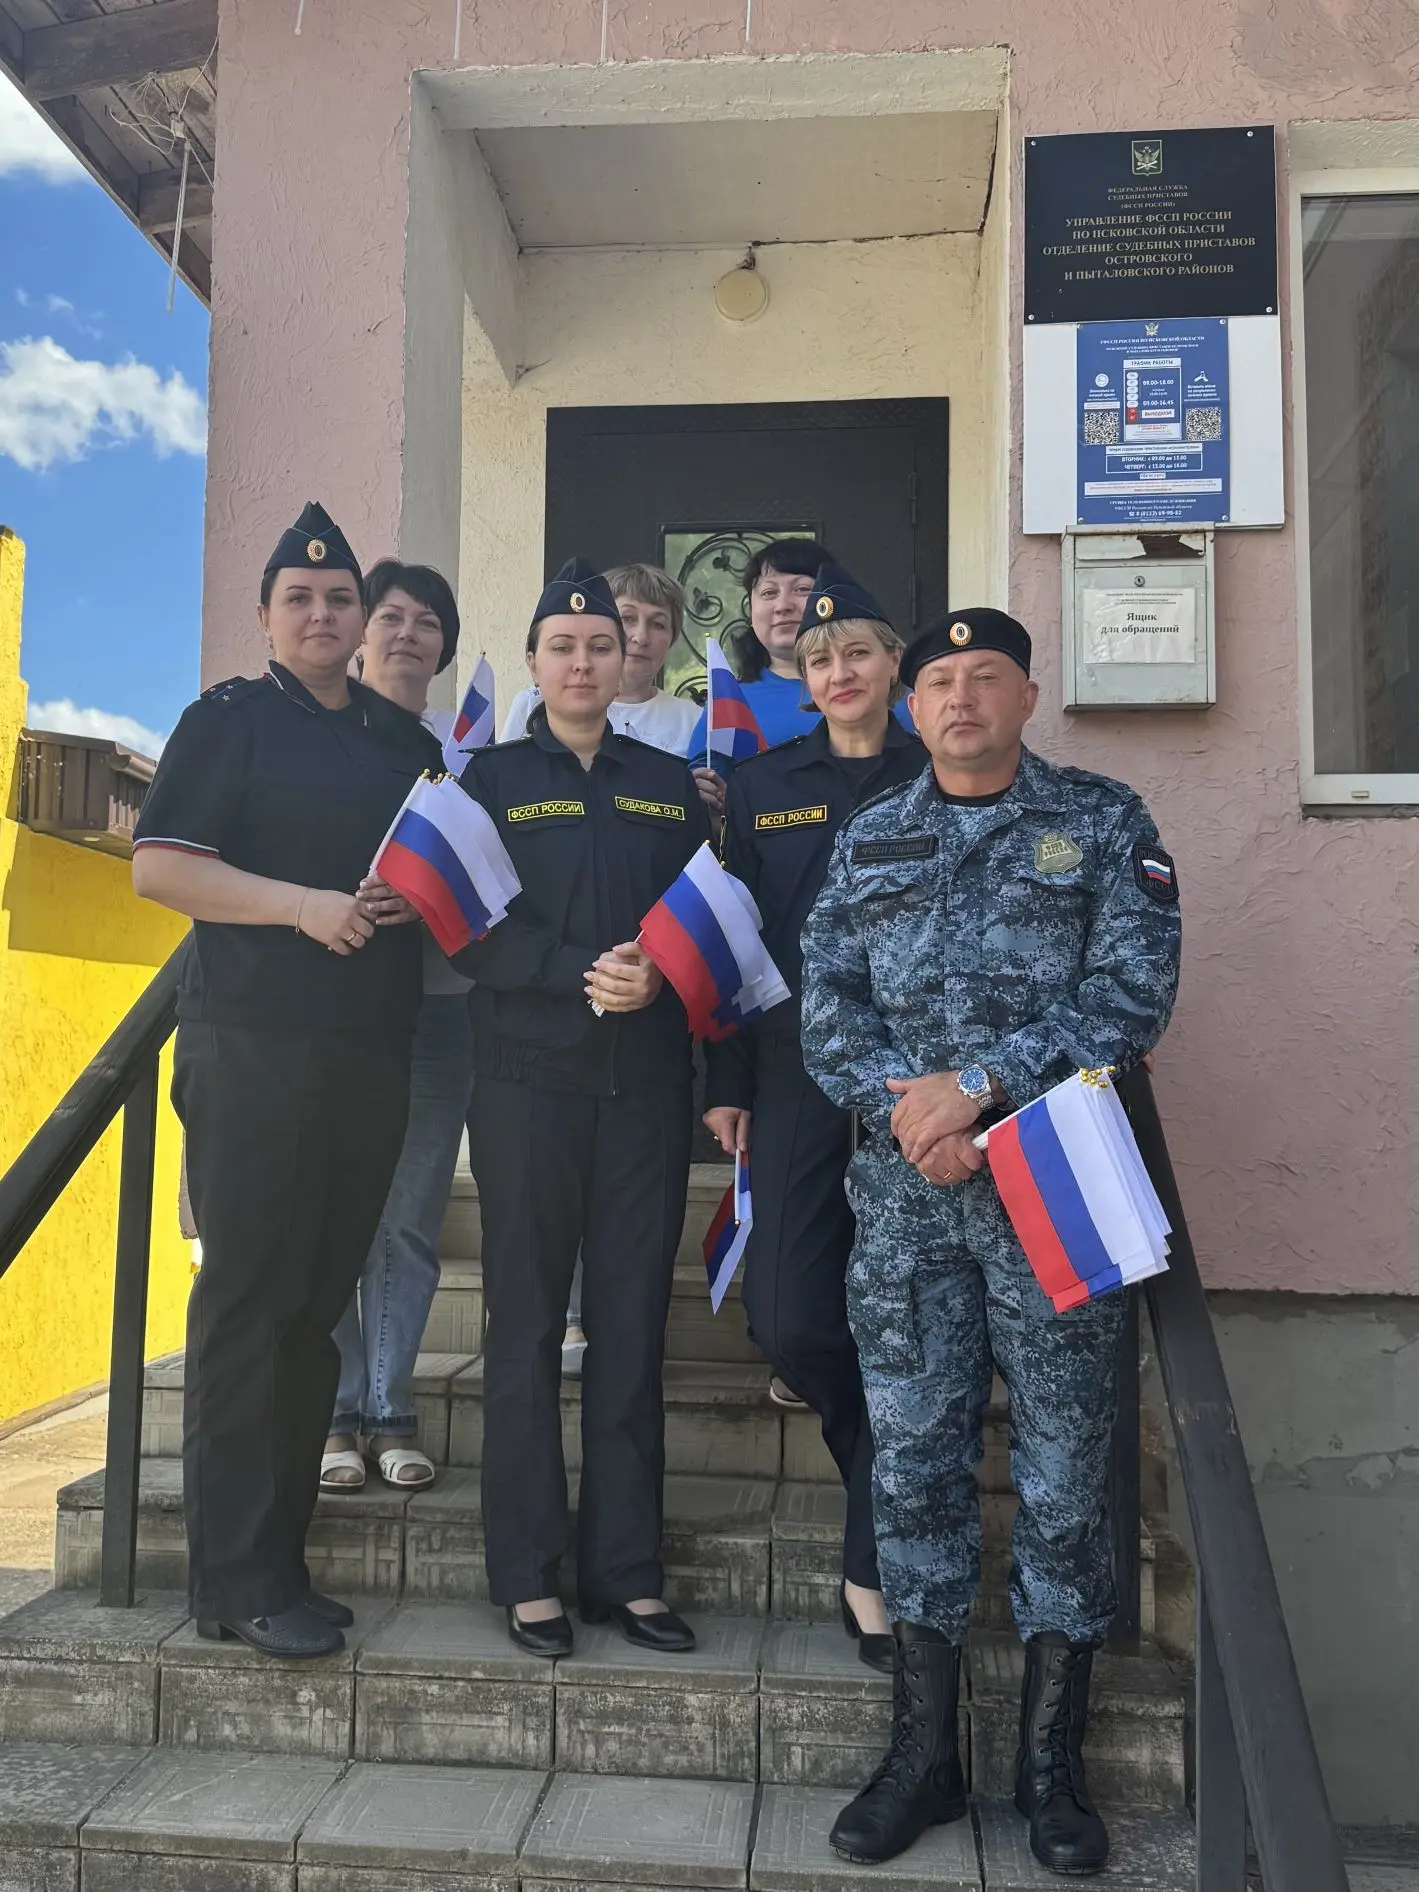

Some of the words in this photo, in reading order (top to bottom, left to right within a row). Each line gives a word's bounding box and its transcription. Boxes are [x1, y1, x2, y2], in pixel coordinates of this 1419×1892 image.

[1065, 214, 1143, 227] УПРАВЛЕНИЕ
[1146, 212, 1180, 223] ФССП
[1183, 211, 1232, 222] РОССИИ
[1072, 230, 1090, 240] ПО
[1092, 226, 1167, 238] ПСКОВСКОЙ
[1169, 224, 1226, 235] ОБЛАСТИ
[1042, 242, 1114, 256] ОТДЕЛЕНИЕ
[1116, 240, 1182, 252] СУДЕБНЫХ
[1184, 237, 1256, 249] ПРИСТАВОВ
[1105, 252, 1193, 265] ОСТРОВСКОГО
[1064, 271, 1074, 281] И
[1076, 266, 1176, 280] ПЫТАЛОВСКОГО
[1178, 264, 1234, 275] РАЙОНОВ
[1127, 612, 1157, 622] Ящик
[1101, 626, 1119, 634] для
[1122, 625, 1179, 635] обращений
[511, 806, 539, 819] ФССП
[541, 804, 581, 813] РОССИИ
[619, 799, 661, 814] СУДАКОВА
[663, 807, 682, 818] О.М.
[760, 816, 785, 826] ФССП
[788, 809, 823, 822] РОССИИ
